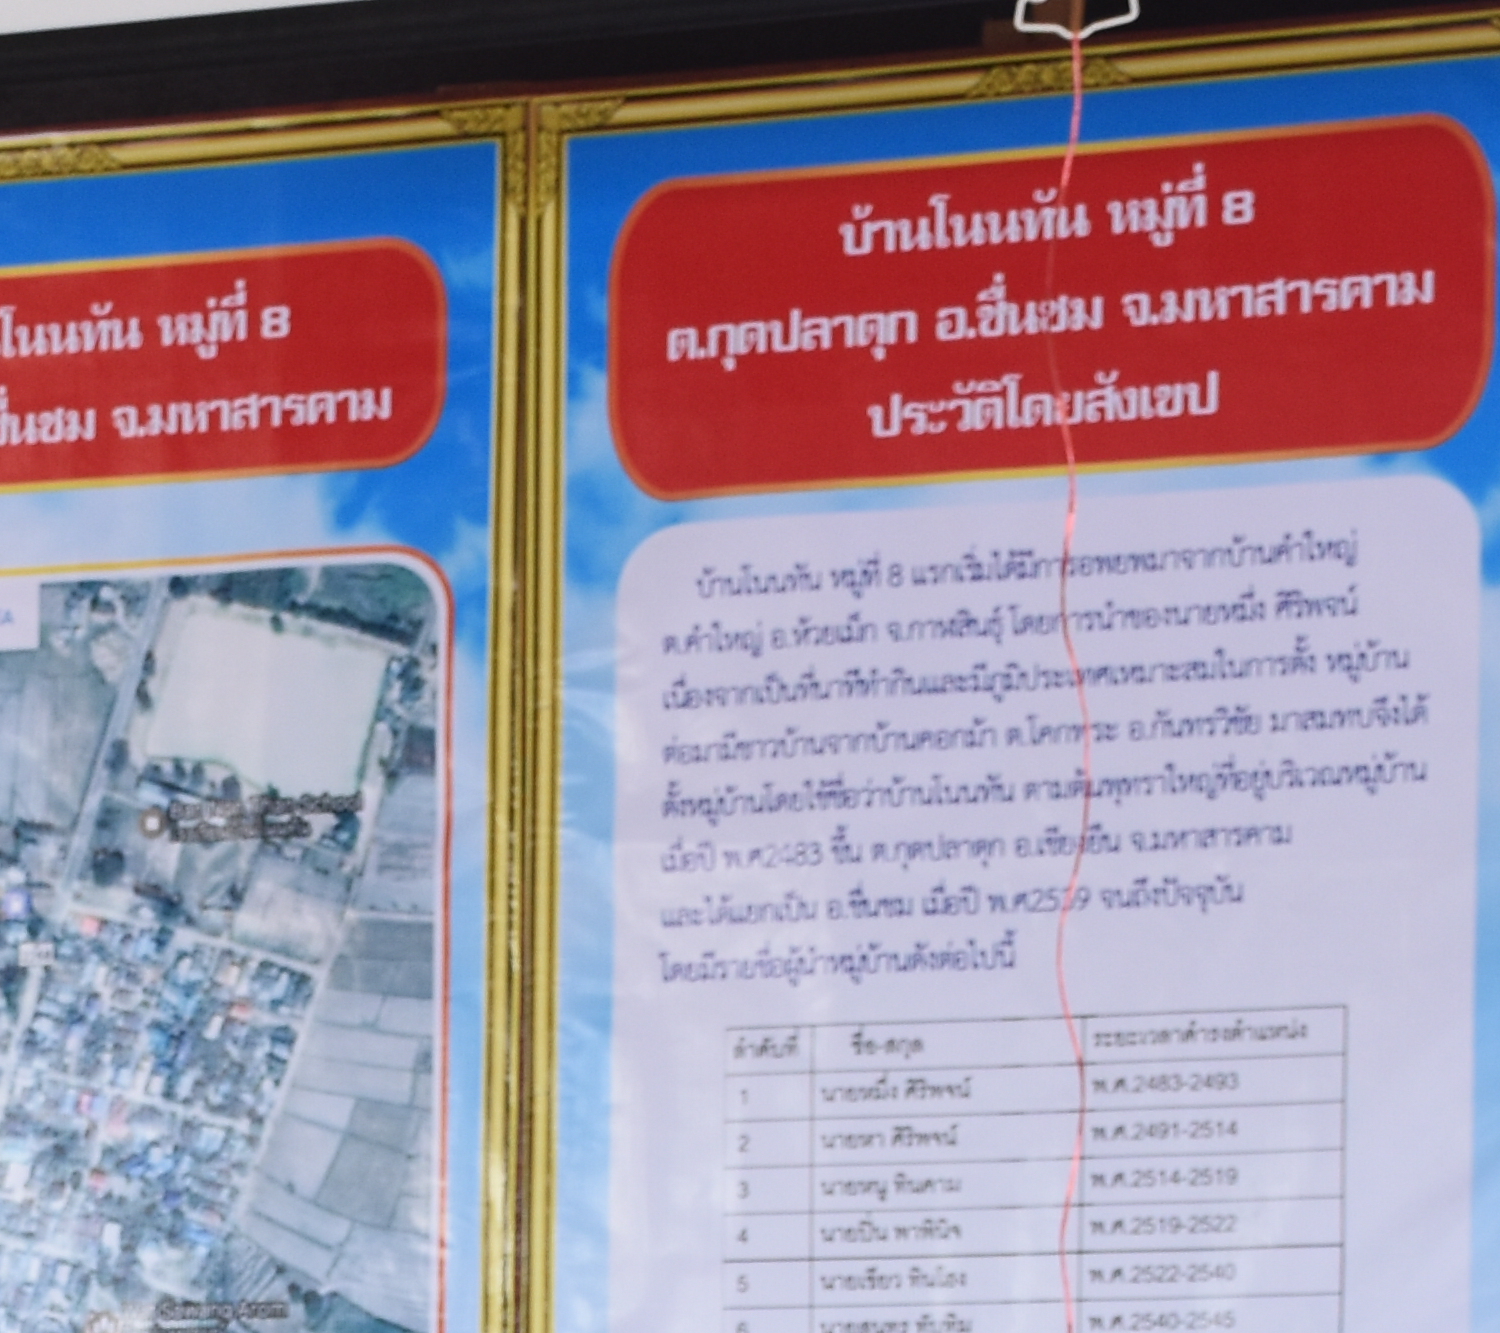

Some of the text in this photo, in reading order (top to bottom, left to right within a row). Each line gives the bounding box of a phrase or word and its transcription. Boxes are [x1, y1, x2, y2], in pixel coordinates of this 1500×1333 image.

[839, 162, 1254, 256] บ้านโนนทัน หมู่ที่ 8
[157, 279, 247, 359] หมู่ที่
[260, 305, 290, 339] 8
[667, 270, 1435, 371] ต.กุดปลาดุก อ.ชื่นชม จ.มหาสารคาม
[111, 387, 392, 438] จ.มหาสารคาม
[867, 370, 1219, 437] ประวัติโดยสังเขป
[887, 562, 904, 588] 8
